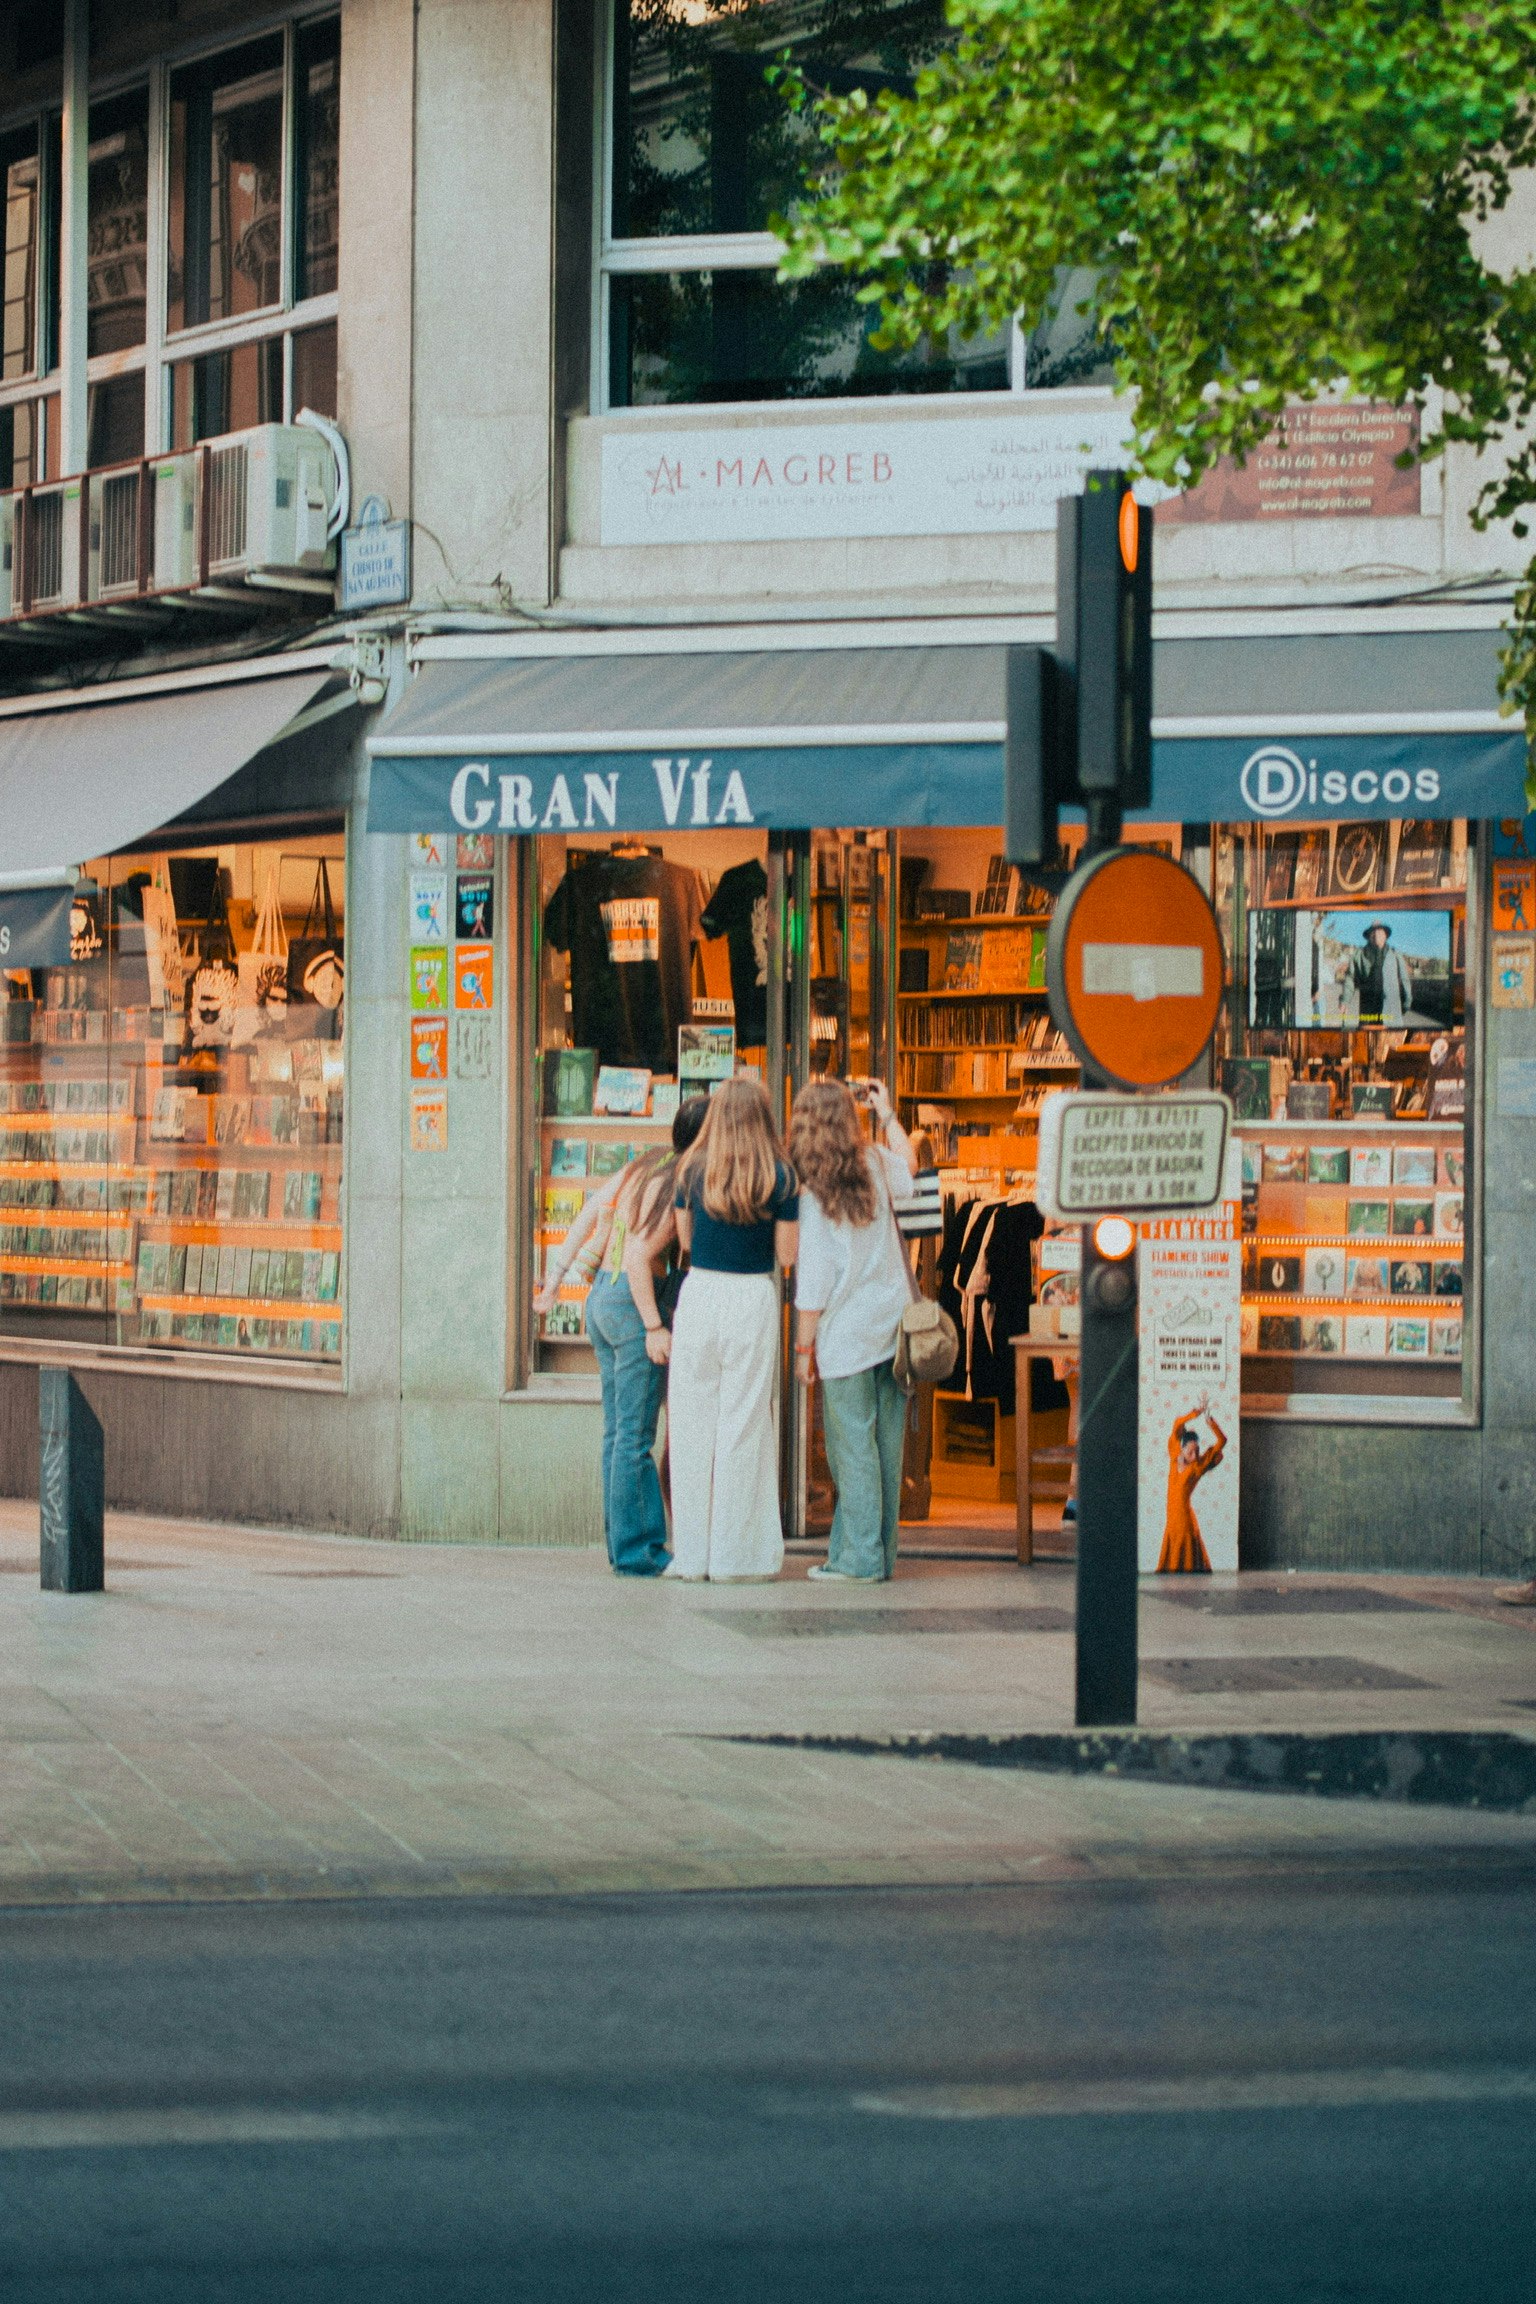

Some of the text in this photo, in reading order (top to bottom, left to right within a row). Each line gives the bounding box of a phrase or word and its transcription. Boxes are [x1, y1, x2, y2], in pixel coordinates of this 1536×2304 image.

[1310, 412, 1360, 426] Escalera
[1362, 409, 1412, 425] Derecha
[1261, 497, 1373, 513] www.al-magreb.com
[1073, 1134, 1128, 1154] EXCEPTO
[1189, 1130, 1204, 1150] DE
[1071, 1155, 1203, 1178] RECOGIDA DE BASURA
[1150, 1221, 1234, 1240] FLAMENCO
[1151, 1250, 1230, 1264] FLAMENCO SHOW
